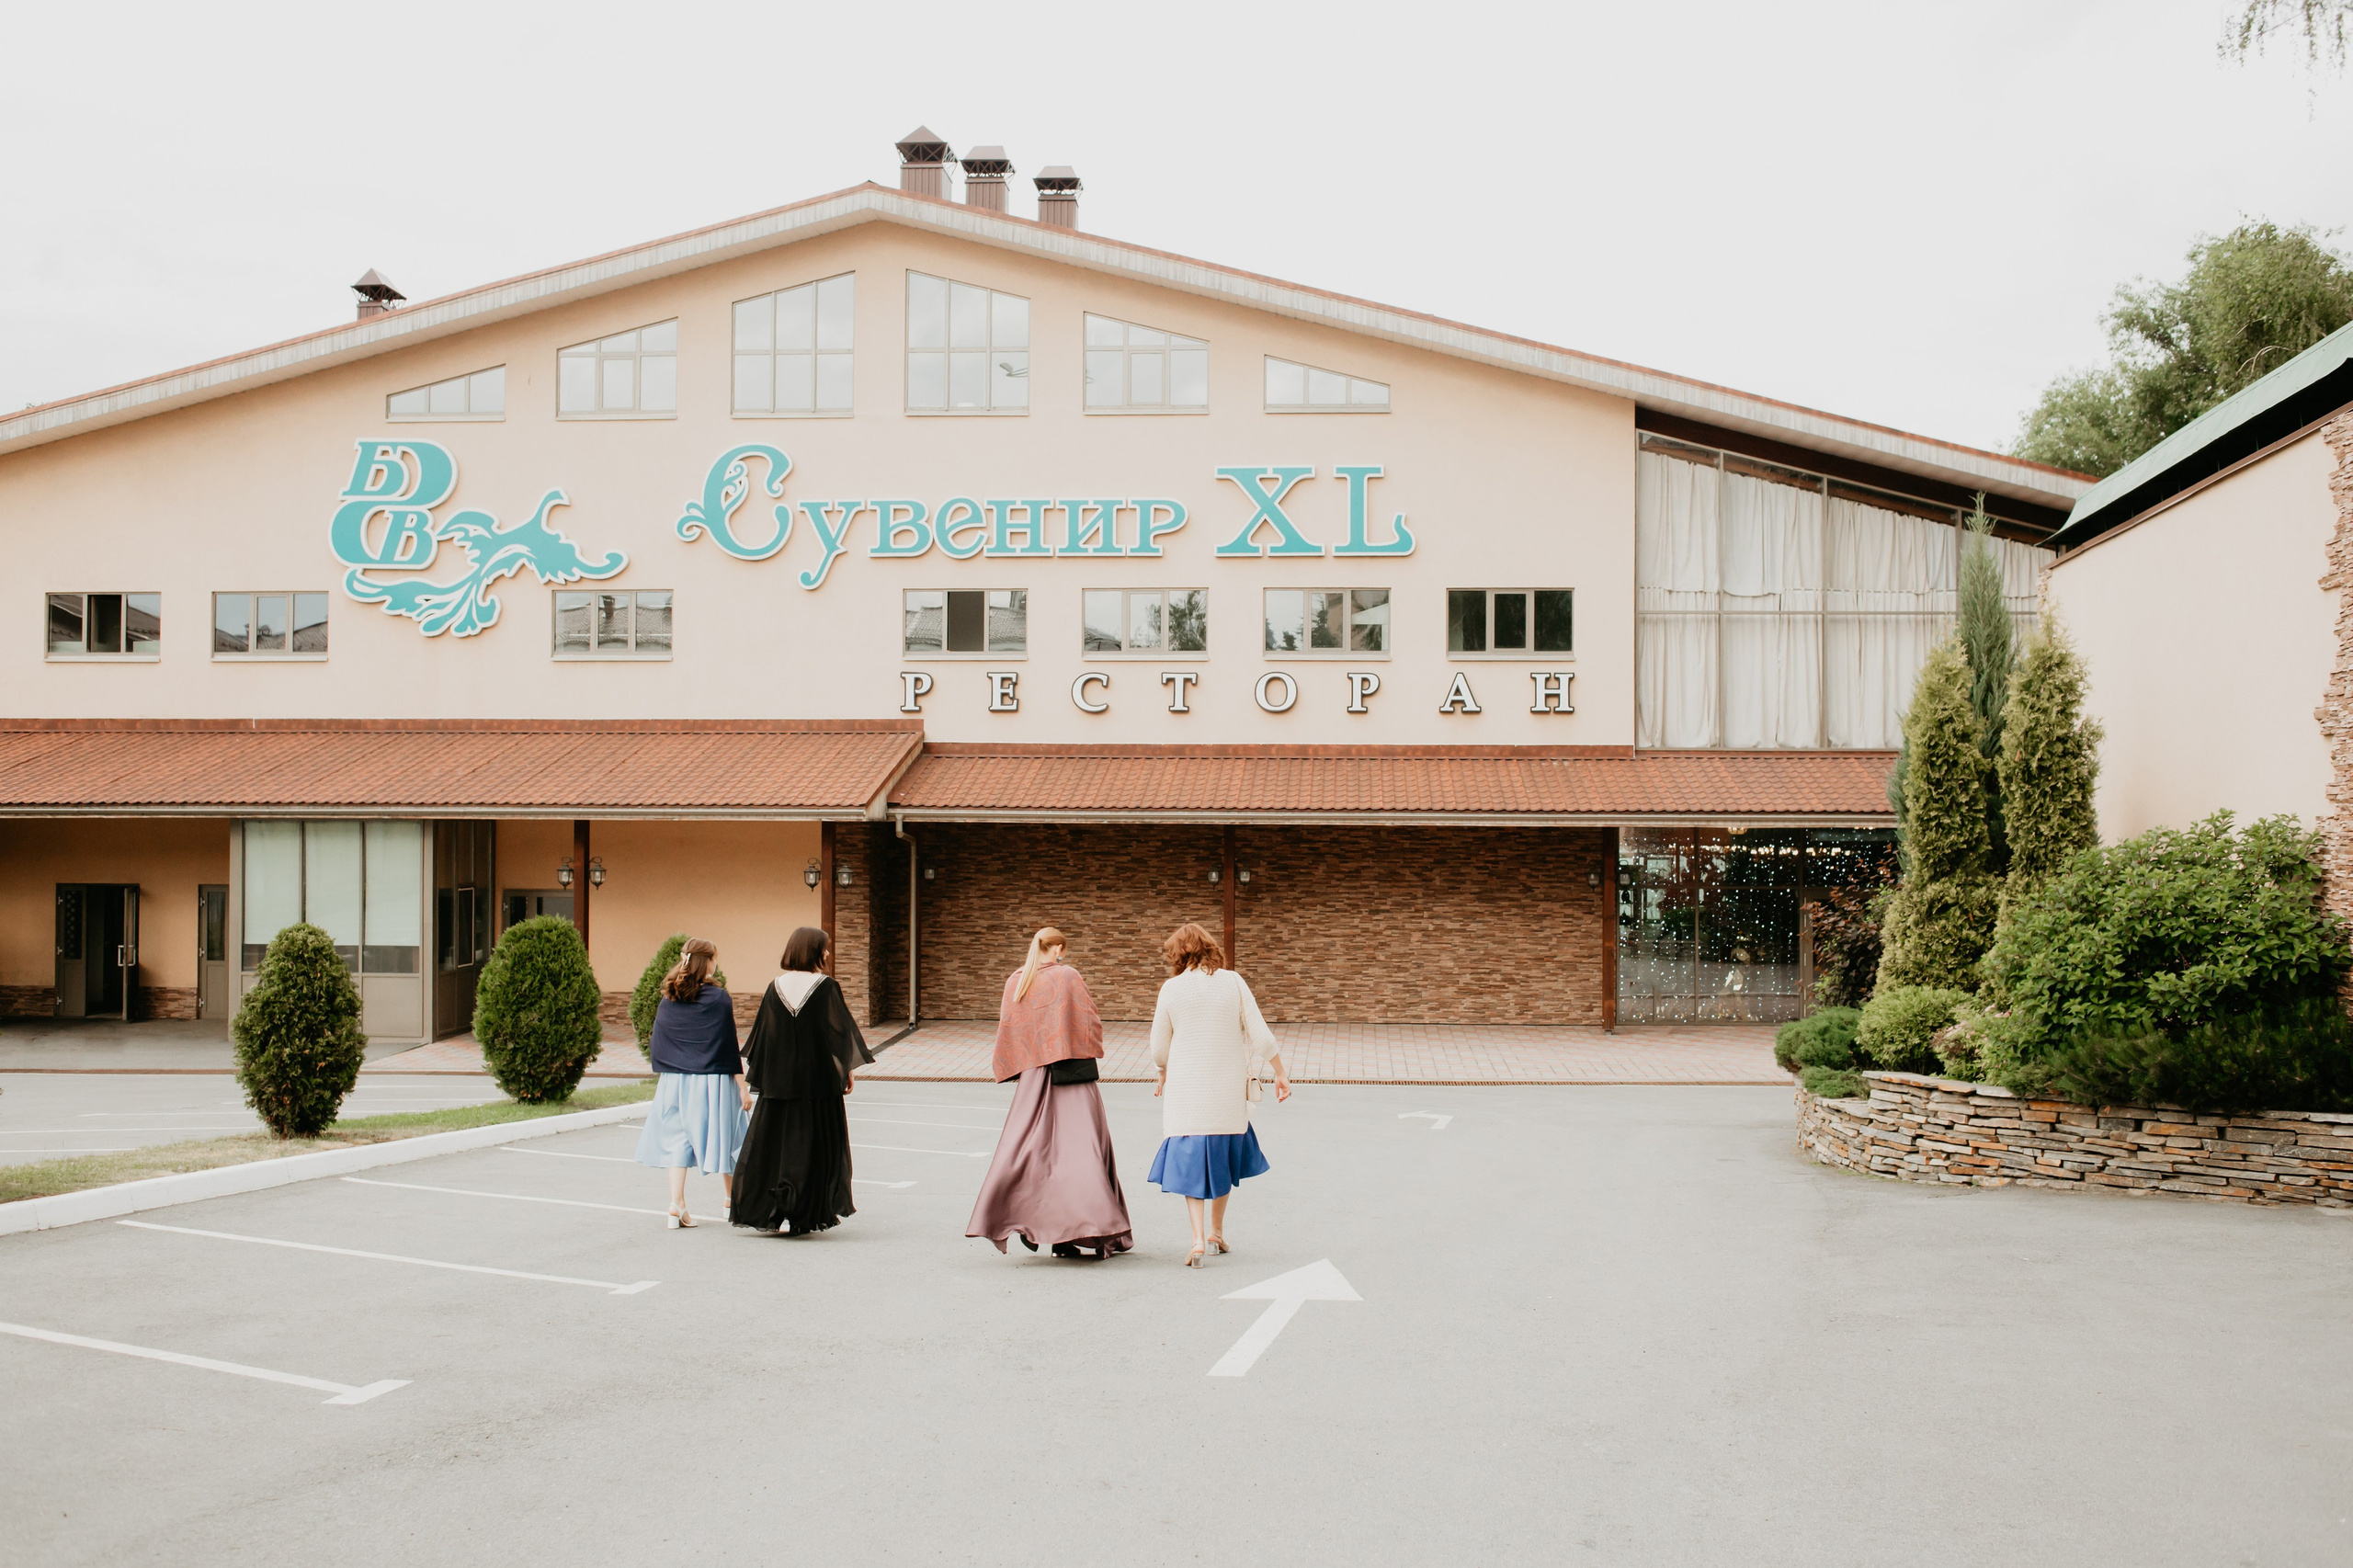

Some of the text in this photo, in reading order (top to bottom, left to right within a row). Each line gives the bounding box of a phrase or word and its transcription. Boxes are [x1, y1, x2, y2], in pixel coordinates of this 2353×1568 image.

[675, 442, 1416, 590] Сувенир XL
[900, 671, 1574, 713] РЕСТОРАН
